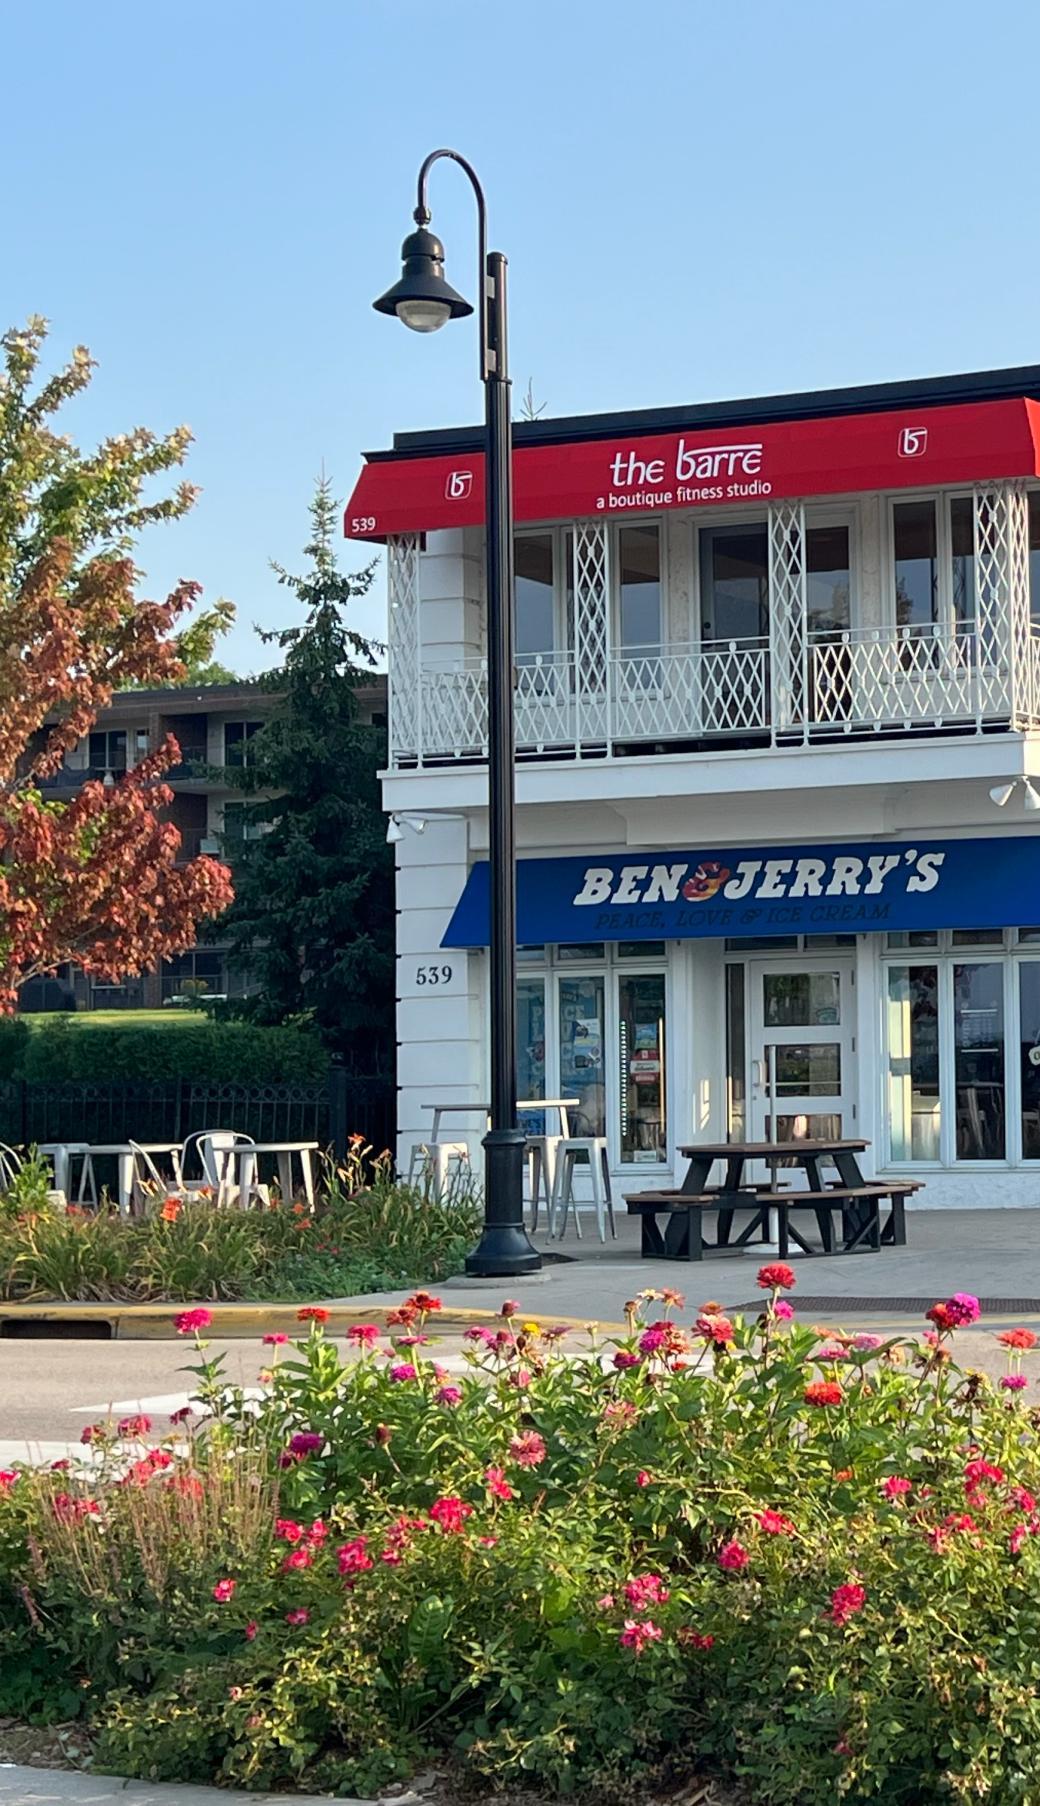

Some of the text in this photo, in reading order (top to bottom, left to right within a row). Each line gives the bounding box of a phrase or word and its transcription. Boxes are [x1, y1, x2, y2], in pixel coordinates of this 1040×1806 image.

[610, 439, 763, 487] the barre
[596, 480, 772, 509] a boutique fitness studio
[352, 517, 376, 532] 539
[675, 909, 736, 927] LOVE
[766, 906, 803, 923] ICE
[810, 903, 890, 922] CREAM
[416, 965, 452, 985] 539
